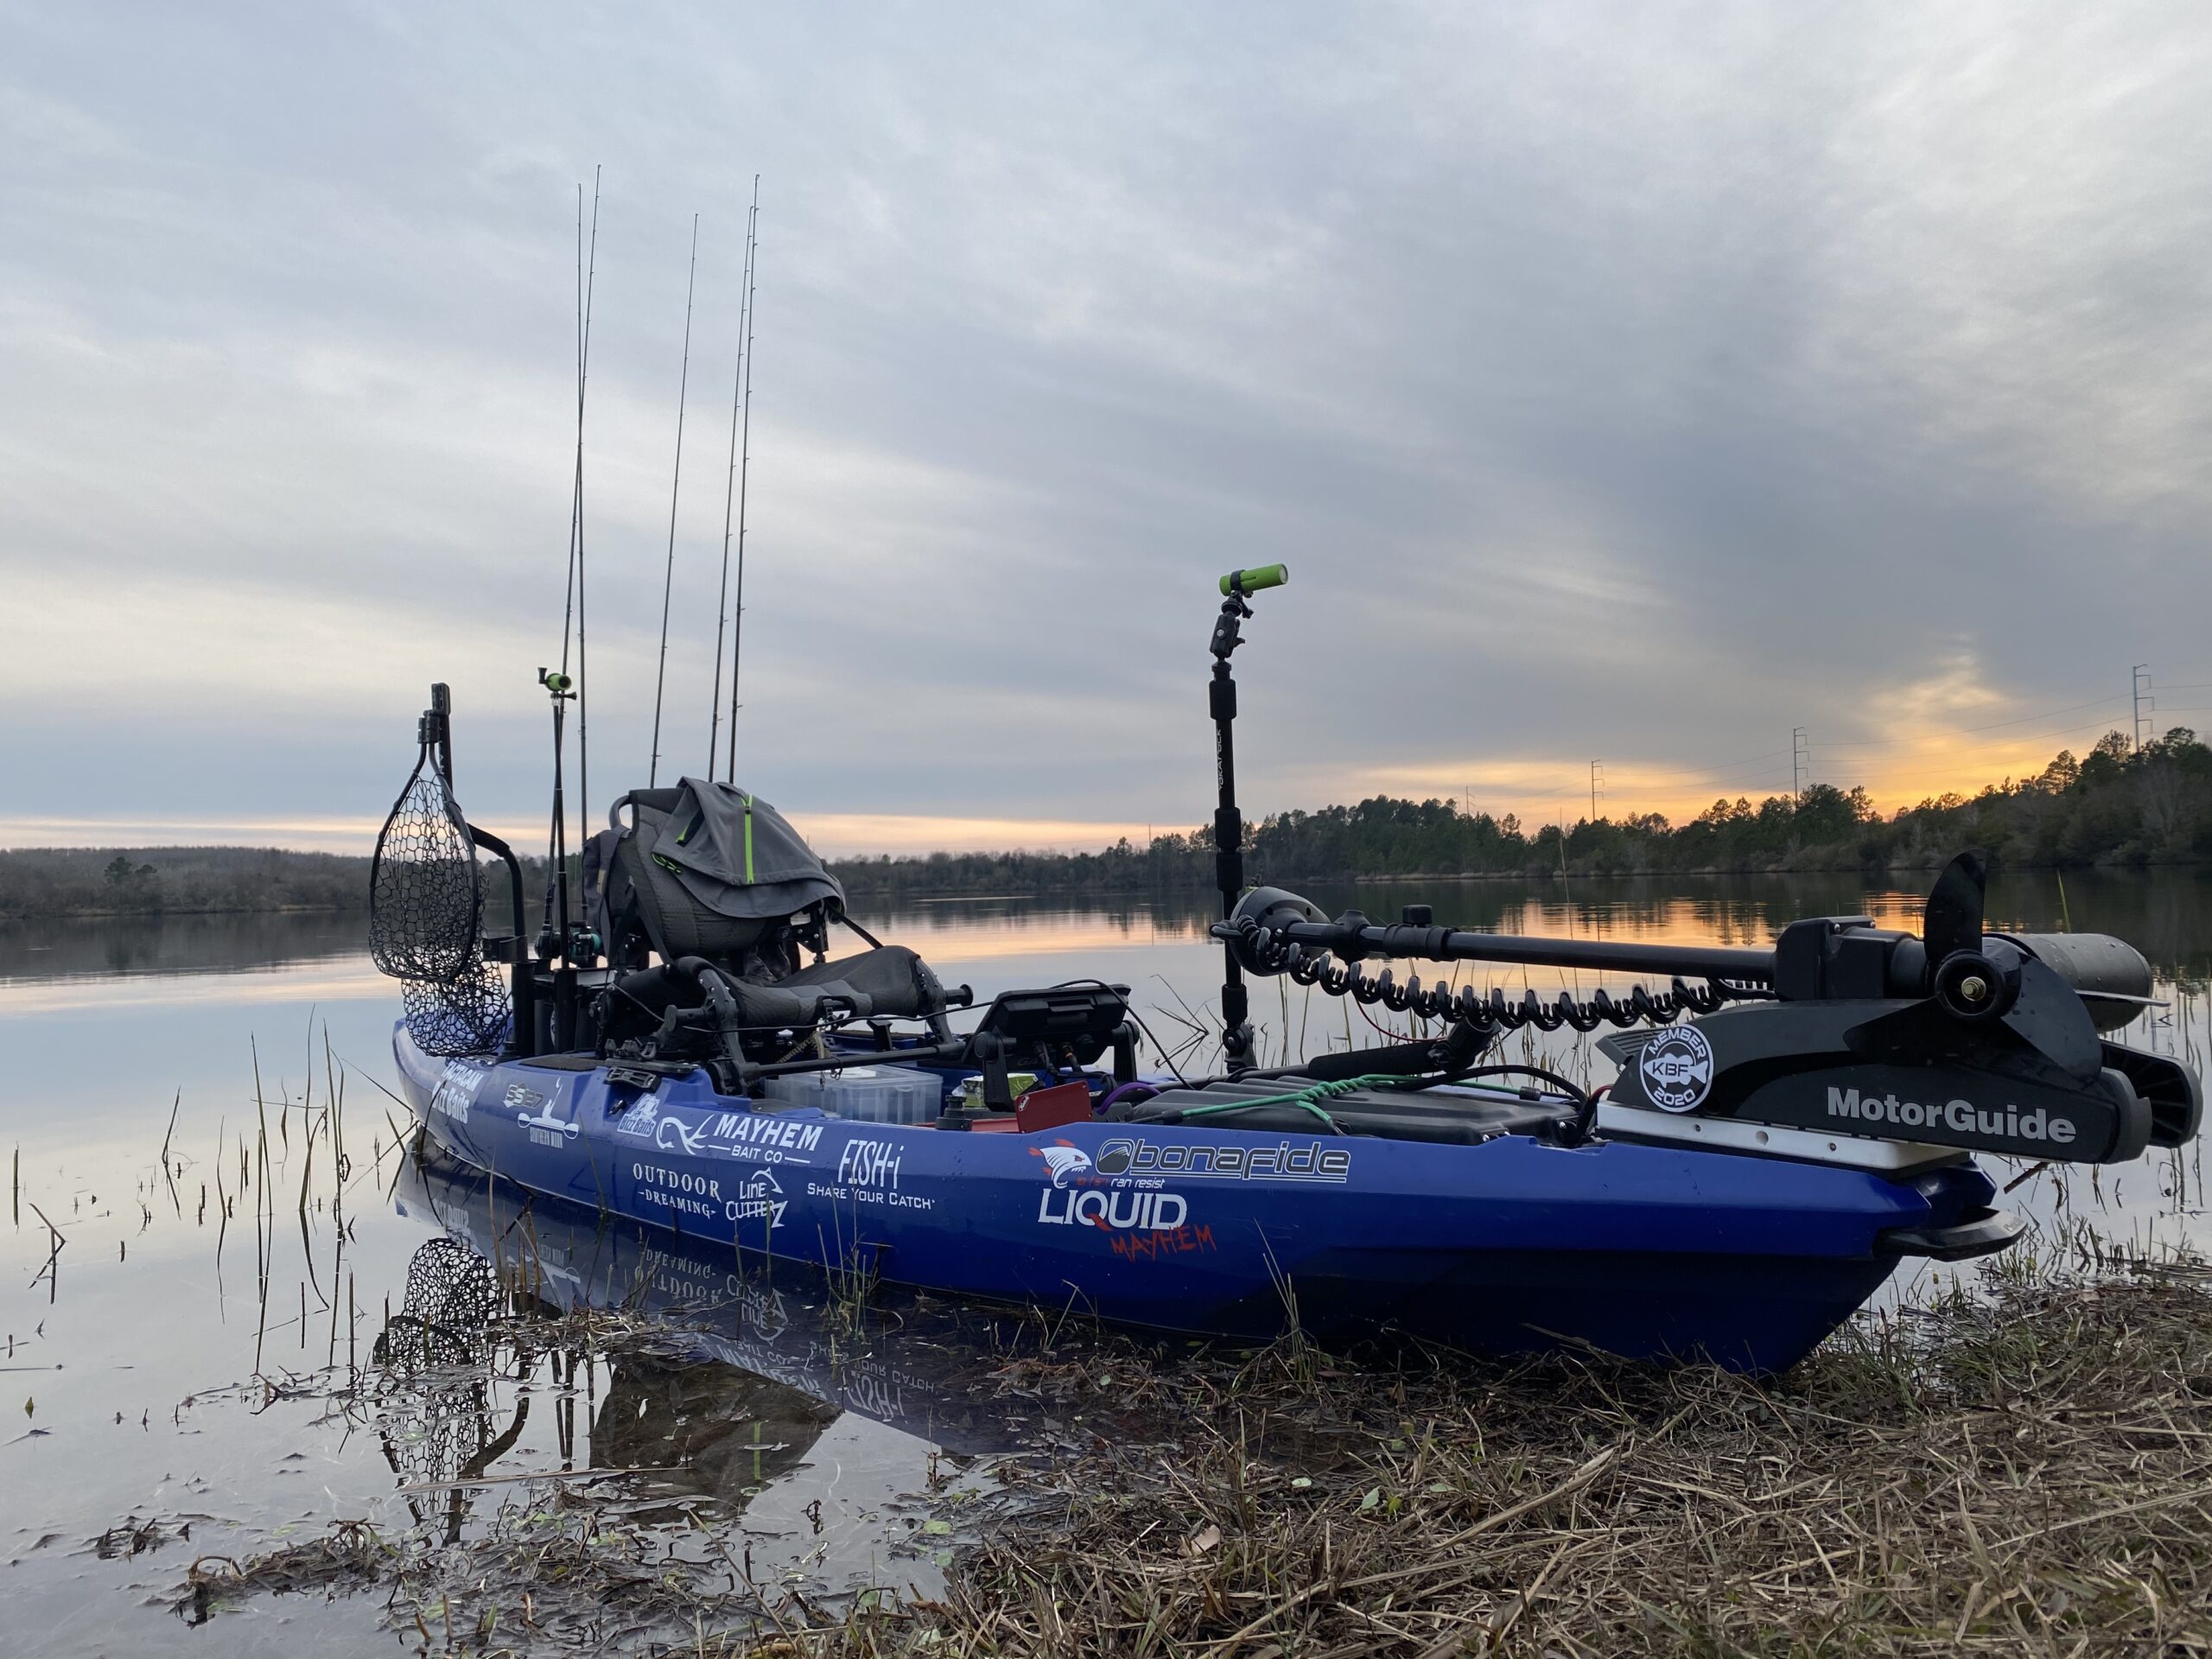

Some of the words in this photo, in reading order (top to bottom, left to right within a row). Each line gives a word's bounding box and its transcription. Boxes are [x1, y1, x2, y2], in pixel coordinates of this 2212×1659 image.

[1648, 1027, 1707, 1059] MEMBER
[1652, 1062, 1689, 1077] KBF
[446, 1087, 470, 1124] Baits
[1653, 1086, 1696, 1106] 2020
[632, 1118, 655, 1135] Baits
[1827, 1086, 2077, 1143] MotorGuide
[713, 1114, 824, 1151] MAYHEM
[731, 1145, 761, 1160] BAIT
[764, 1150, 783, 1163] CO
[1129, 1138, 1351, 1180] bonafide
[632, 1163, 722, 1203] OUTDOOR
[807, 1182, 847, 1199] SHARE
[851, 1188, 884, 1204] YOUR
[1135, 1177, 1166, 1189] resist
[1037, 1188, 1187, 1230] LIQUID
[1109, 1224, 1217, 1264] MAYHEM
